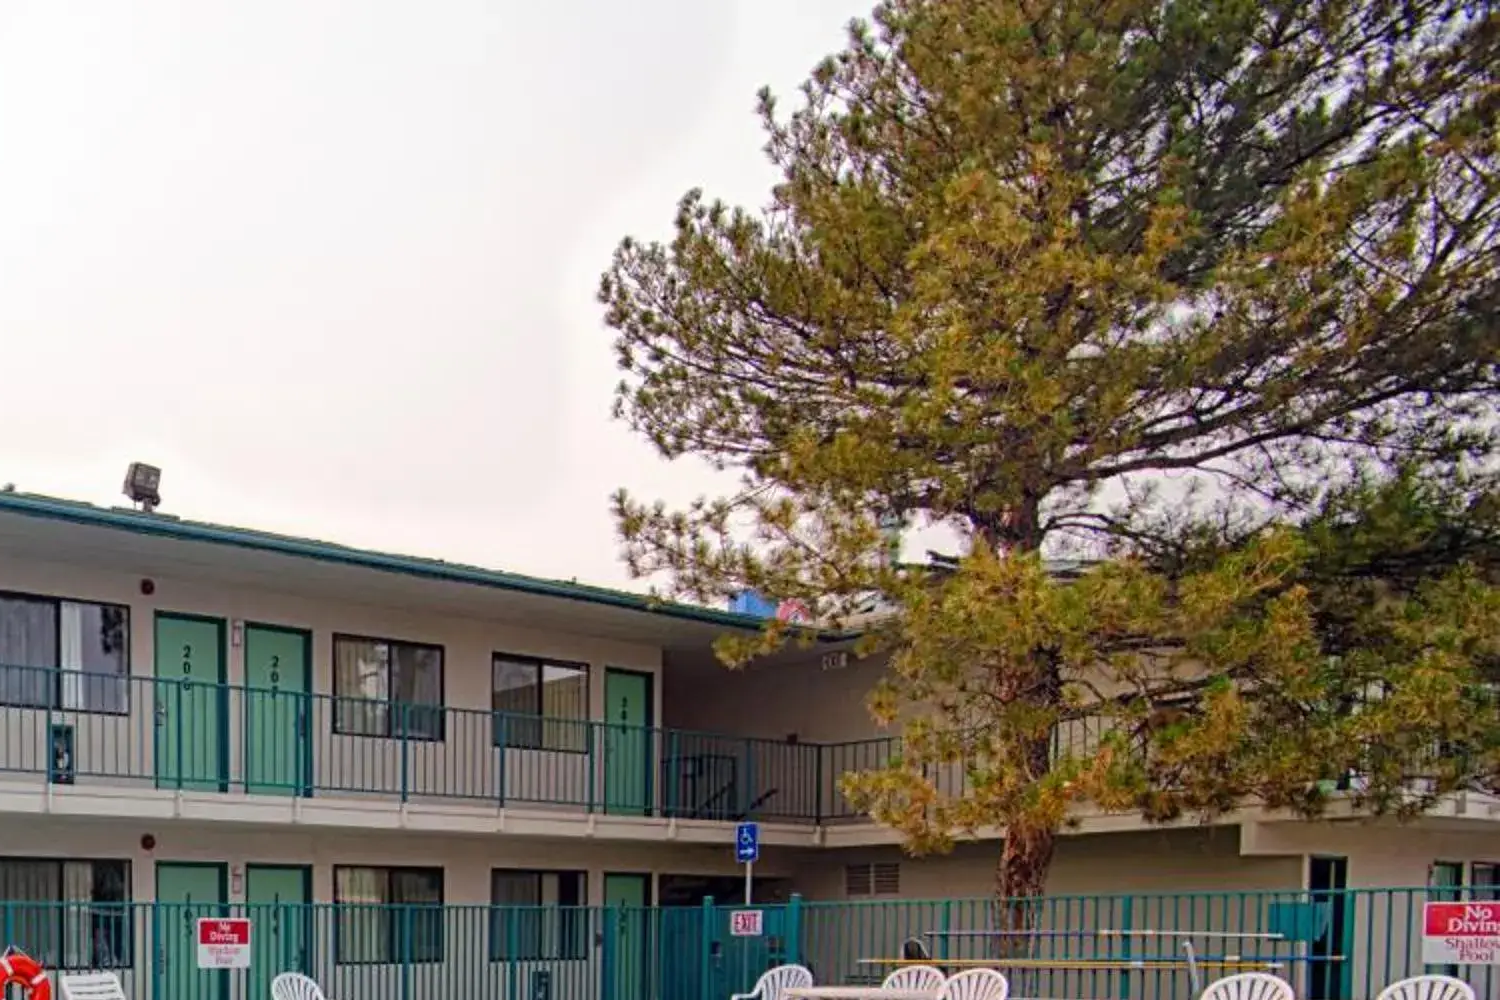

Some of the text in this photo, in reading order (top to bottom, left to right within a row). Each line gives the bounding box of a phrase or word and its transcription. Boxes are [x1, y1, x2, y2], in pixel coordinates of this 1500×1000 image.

[1465, 905, 1492, 920] No
[219, 921, 231, 931] No
[734, 912, 758, 932] EXIT
[1446, 917, 1500, 936] Divin
[1459, 950, 1494, 961] Pool
